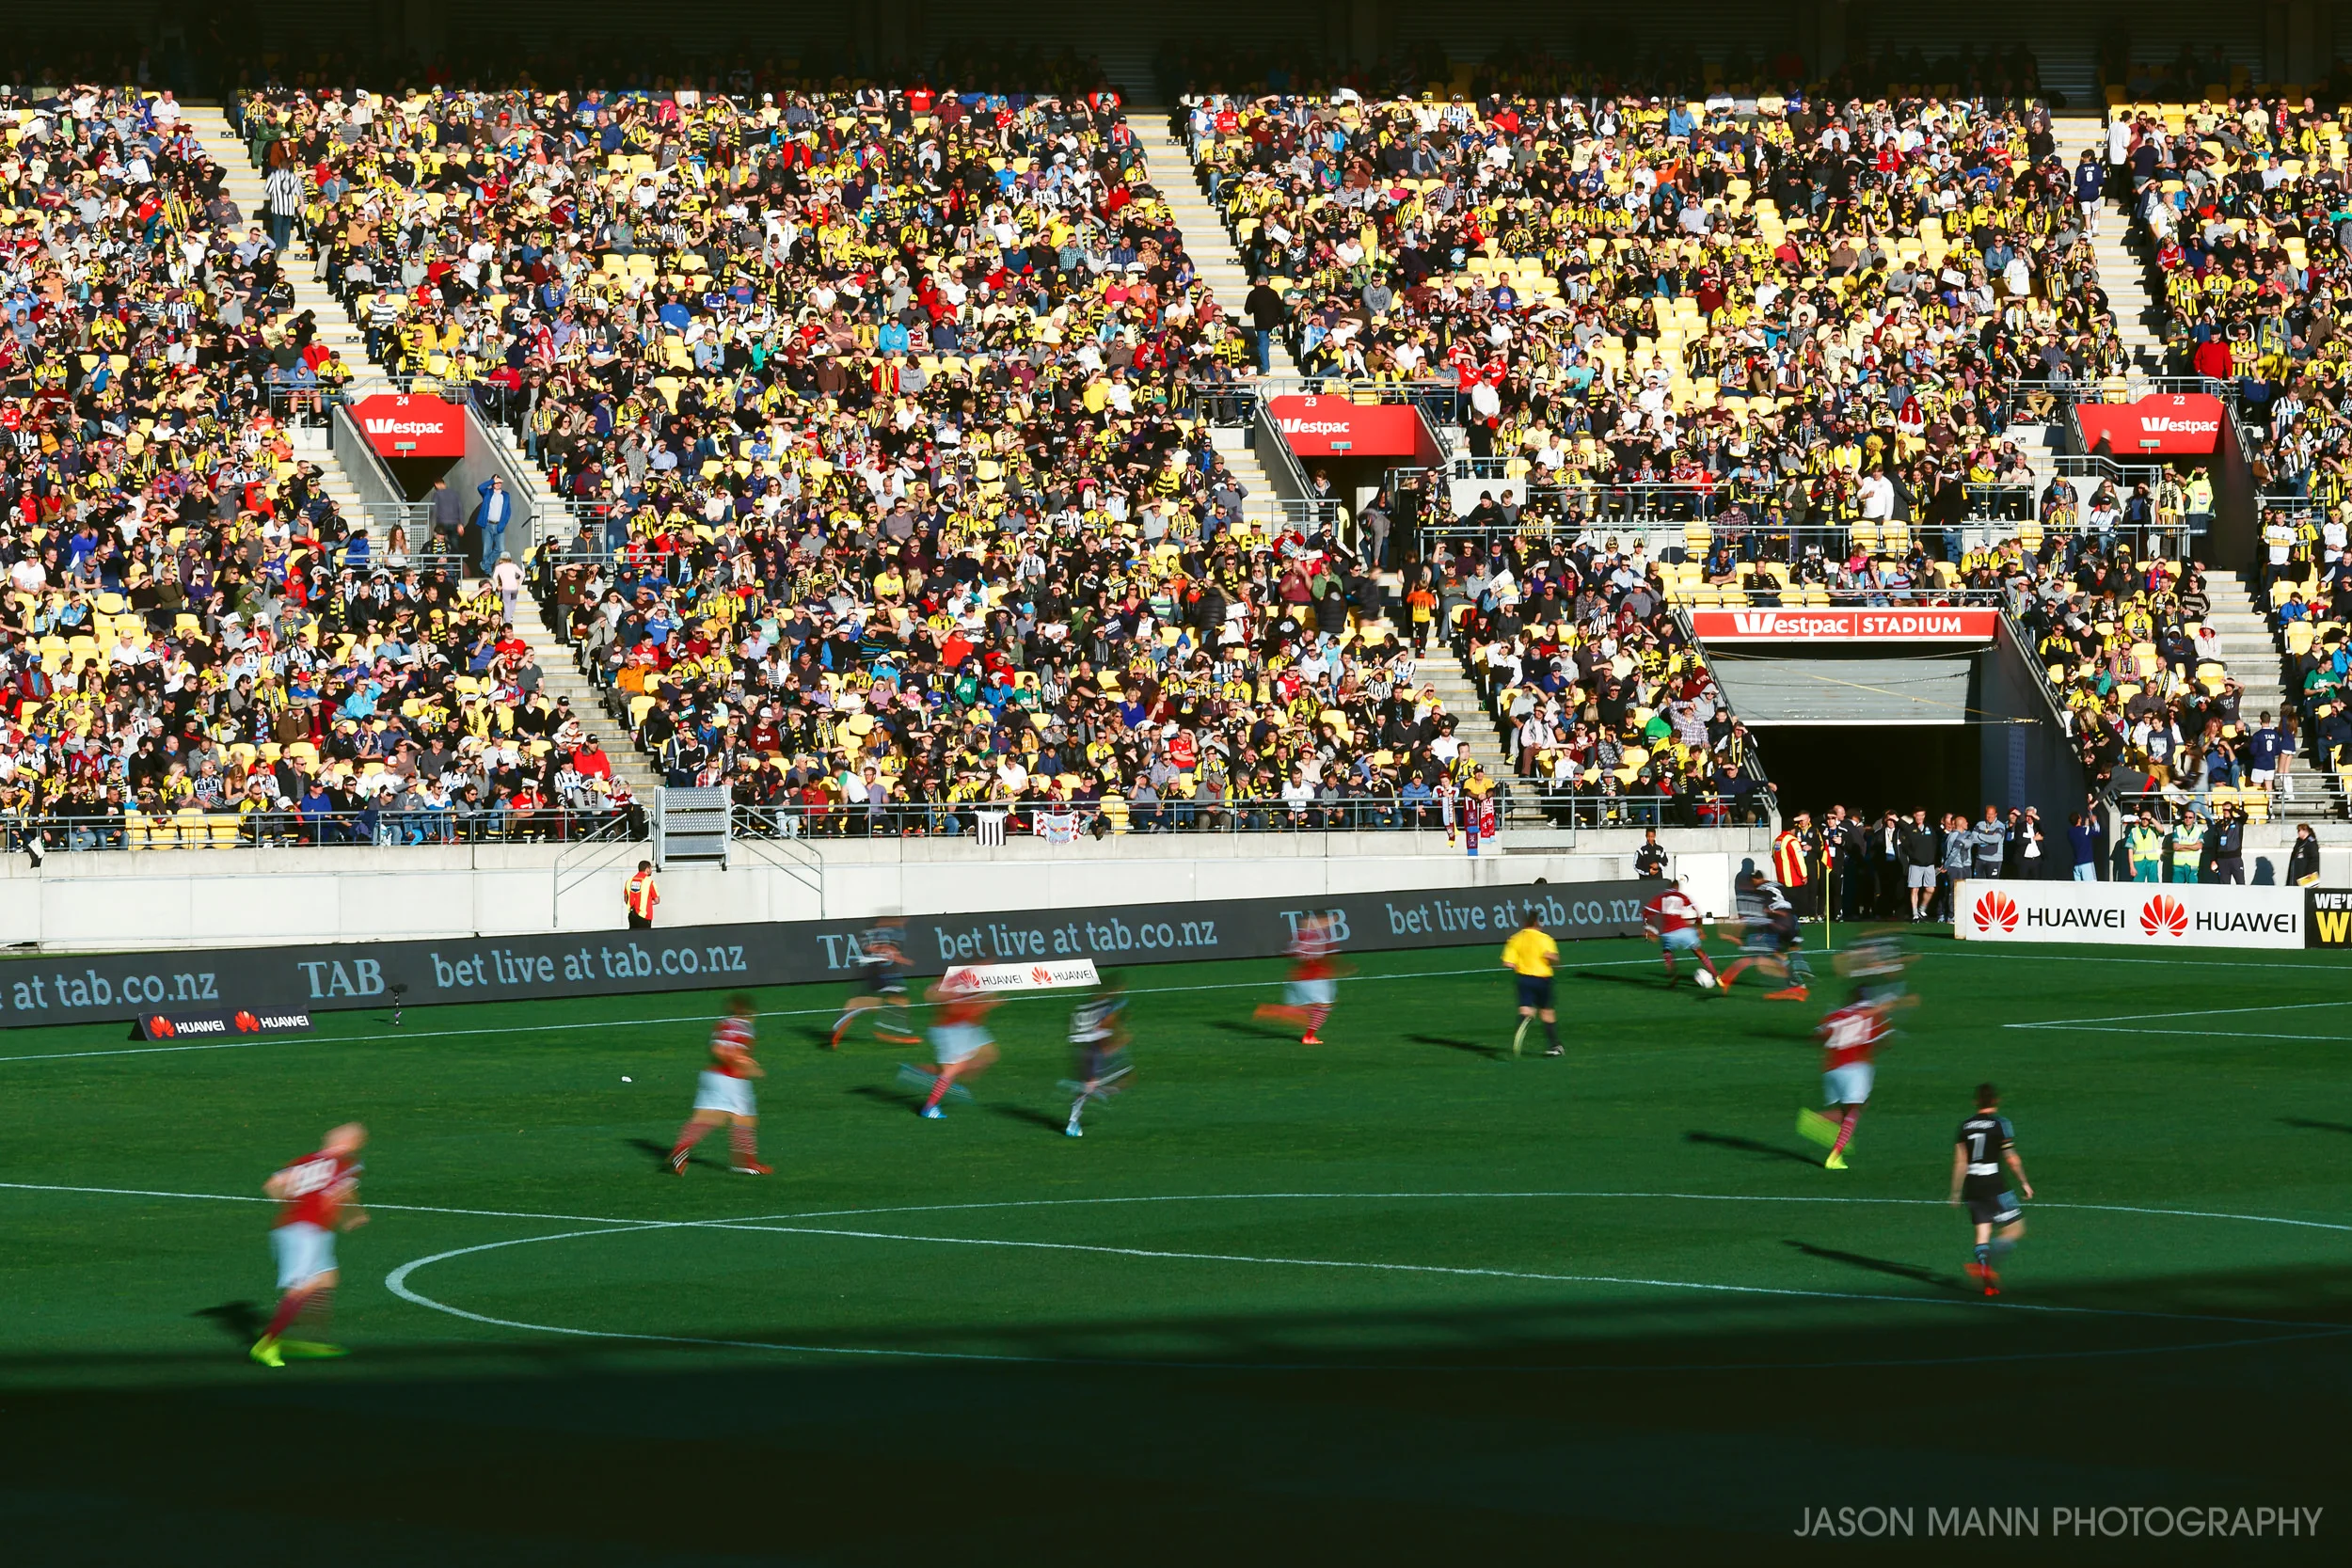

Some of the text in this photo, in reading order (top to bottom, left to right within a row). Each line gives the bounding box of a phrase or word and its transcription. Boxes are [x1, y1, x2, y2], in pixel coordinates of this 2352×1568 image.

[396, 396, 409, 405] 24
[1305, 397, 1317, 406] 23
[2173, 396, 2185, 405] 22
[365, 419, 443, 436] Westpac
[1276, 419, 1349, 436] Westpac
[2140, 417, 2217, 434] Westpac
[1733, 613, 1962, 637] Westpac STADIUM
[1385, 903, 1431, 935] bet
[1434, 900, 1486, 932] live
[1493, 899, 1518, 928] at
[1523, 895, 1643, 927] tab.co.nz
[2027, 907, 2125, 928] HUAWEI
[2197, 911, 2296, 933] HUAWEI
[1279, 909, 1350, 943] TAB
[2315, 911, 2352, 943] W
[934, 917, 1218, 960] bet live at tab.co.nz
[431, 942, 747, 989] bet live at tab.co.nz
[297, 958, 385, 998] TAB
[981, 974, 1024, 986] HUAWEI
[1053, 970, 1094, 981] HUAWEI
[13, 975, 49, 1010] at
[55, 970, 219, 1008] tab.co.nz
[175, 1020, 226, 1035] HUAWEI
[261, 1014, 310, 1029] HUAWEI
